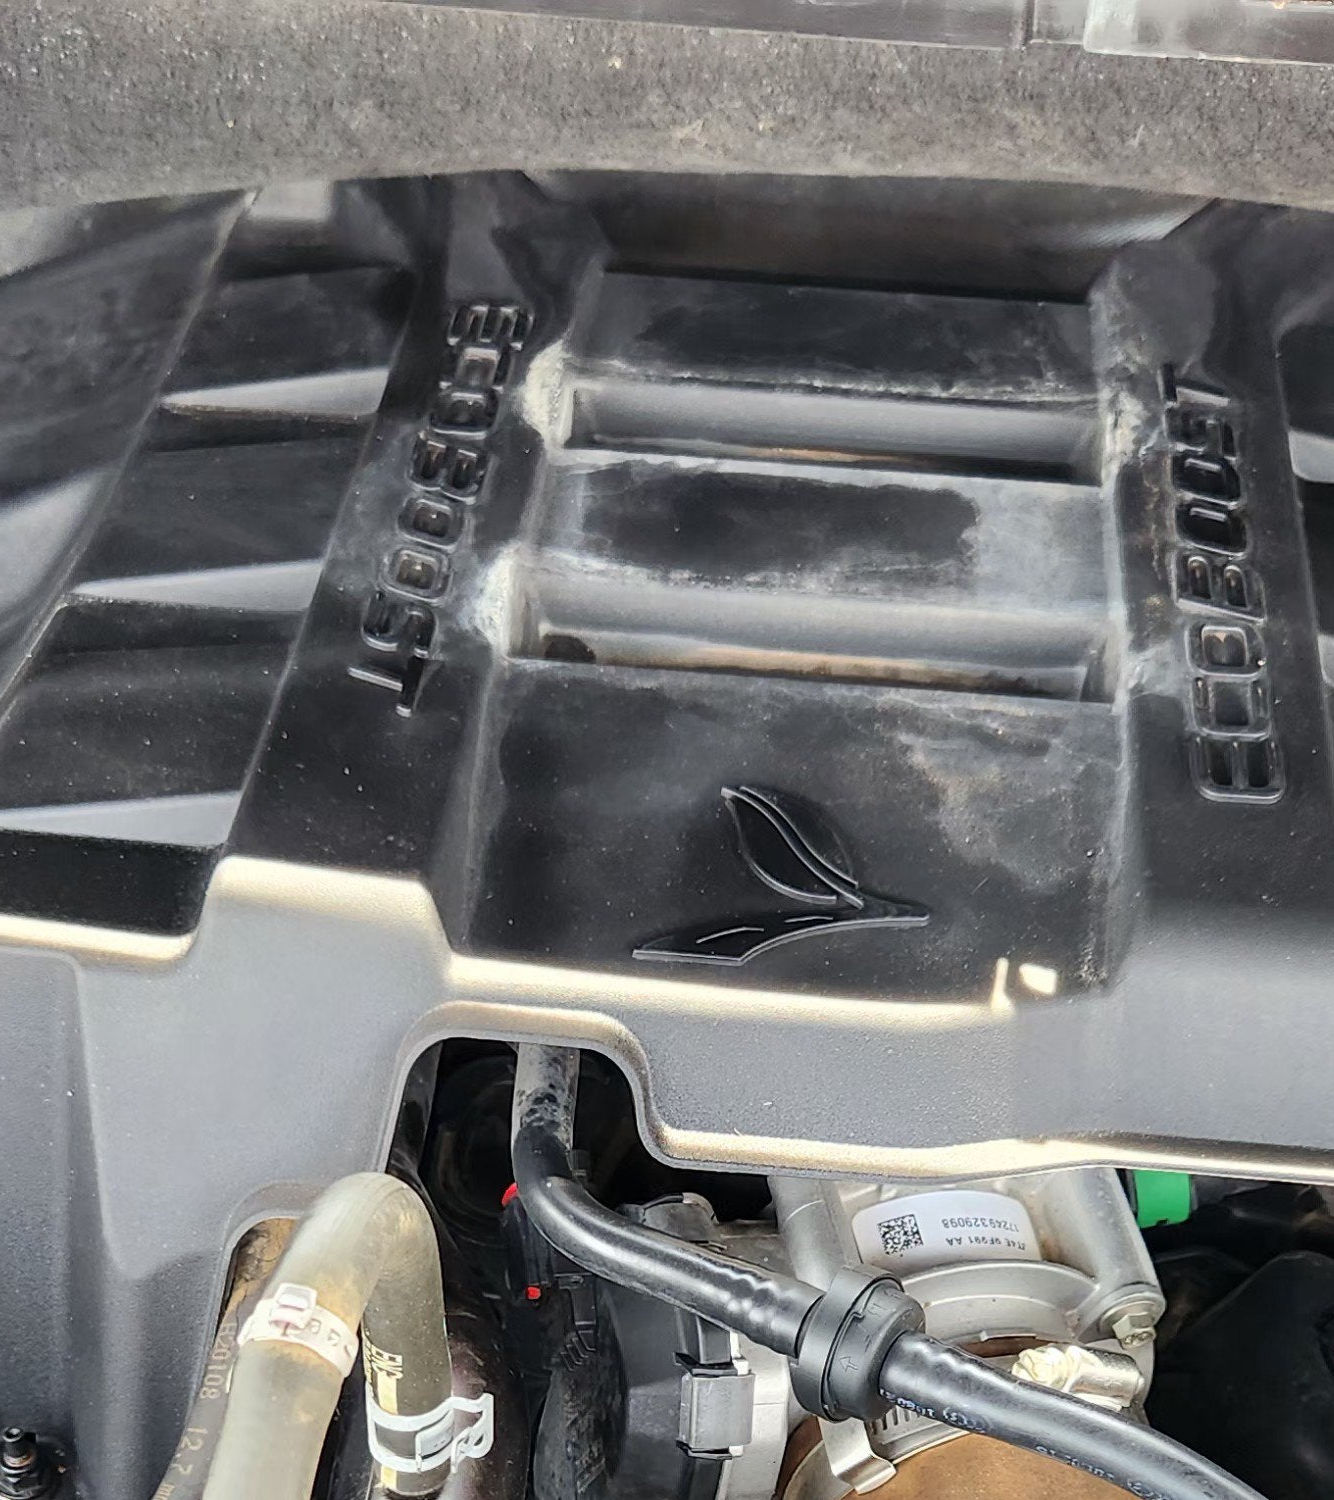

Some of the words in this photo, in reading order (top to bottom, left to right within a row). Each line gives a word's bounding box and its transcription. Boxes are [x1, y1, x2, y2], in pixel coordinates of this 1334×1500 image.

[347, 304, 535, 718] ECOBOOST
[1159, 362, 1287, 805] ECOBOOST
[945, 1237, 963, 1246] AA
